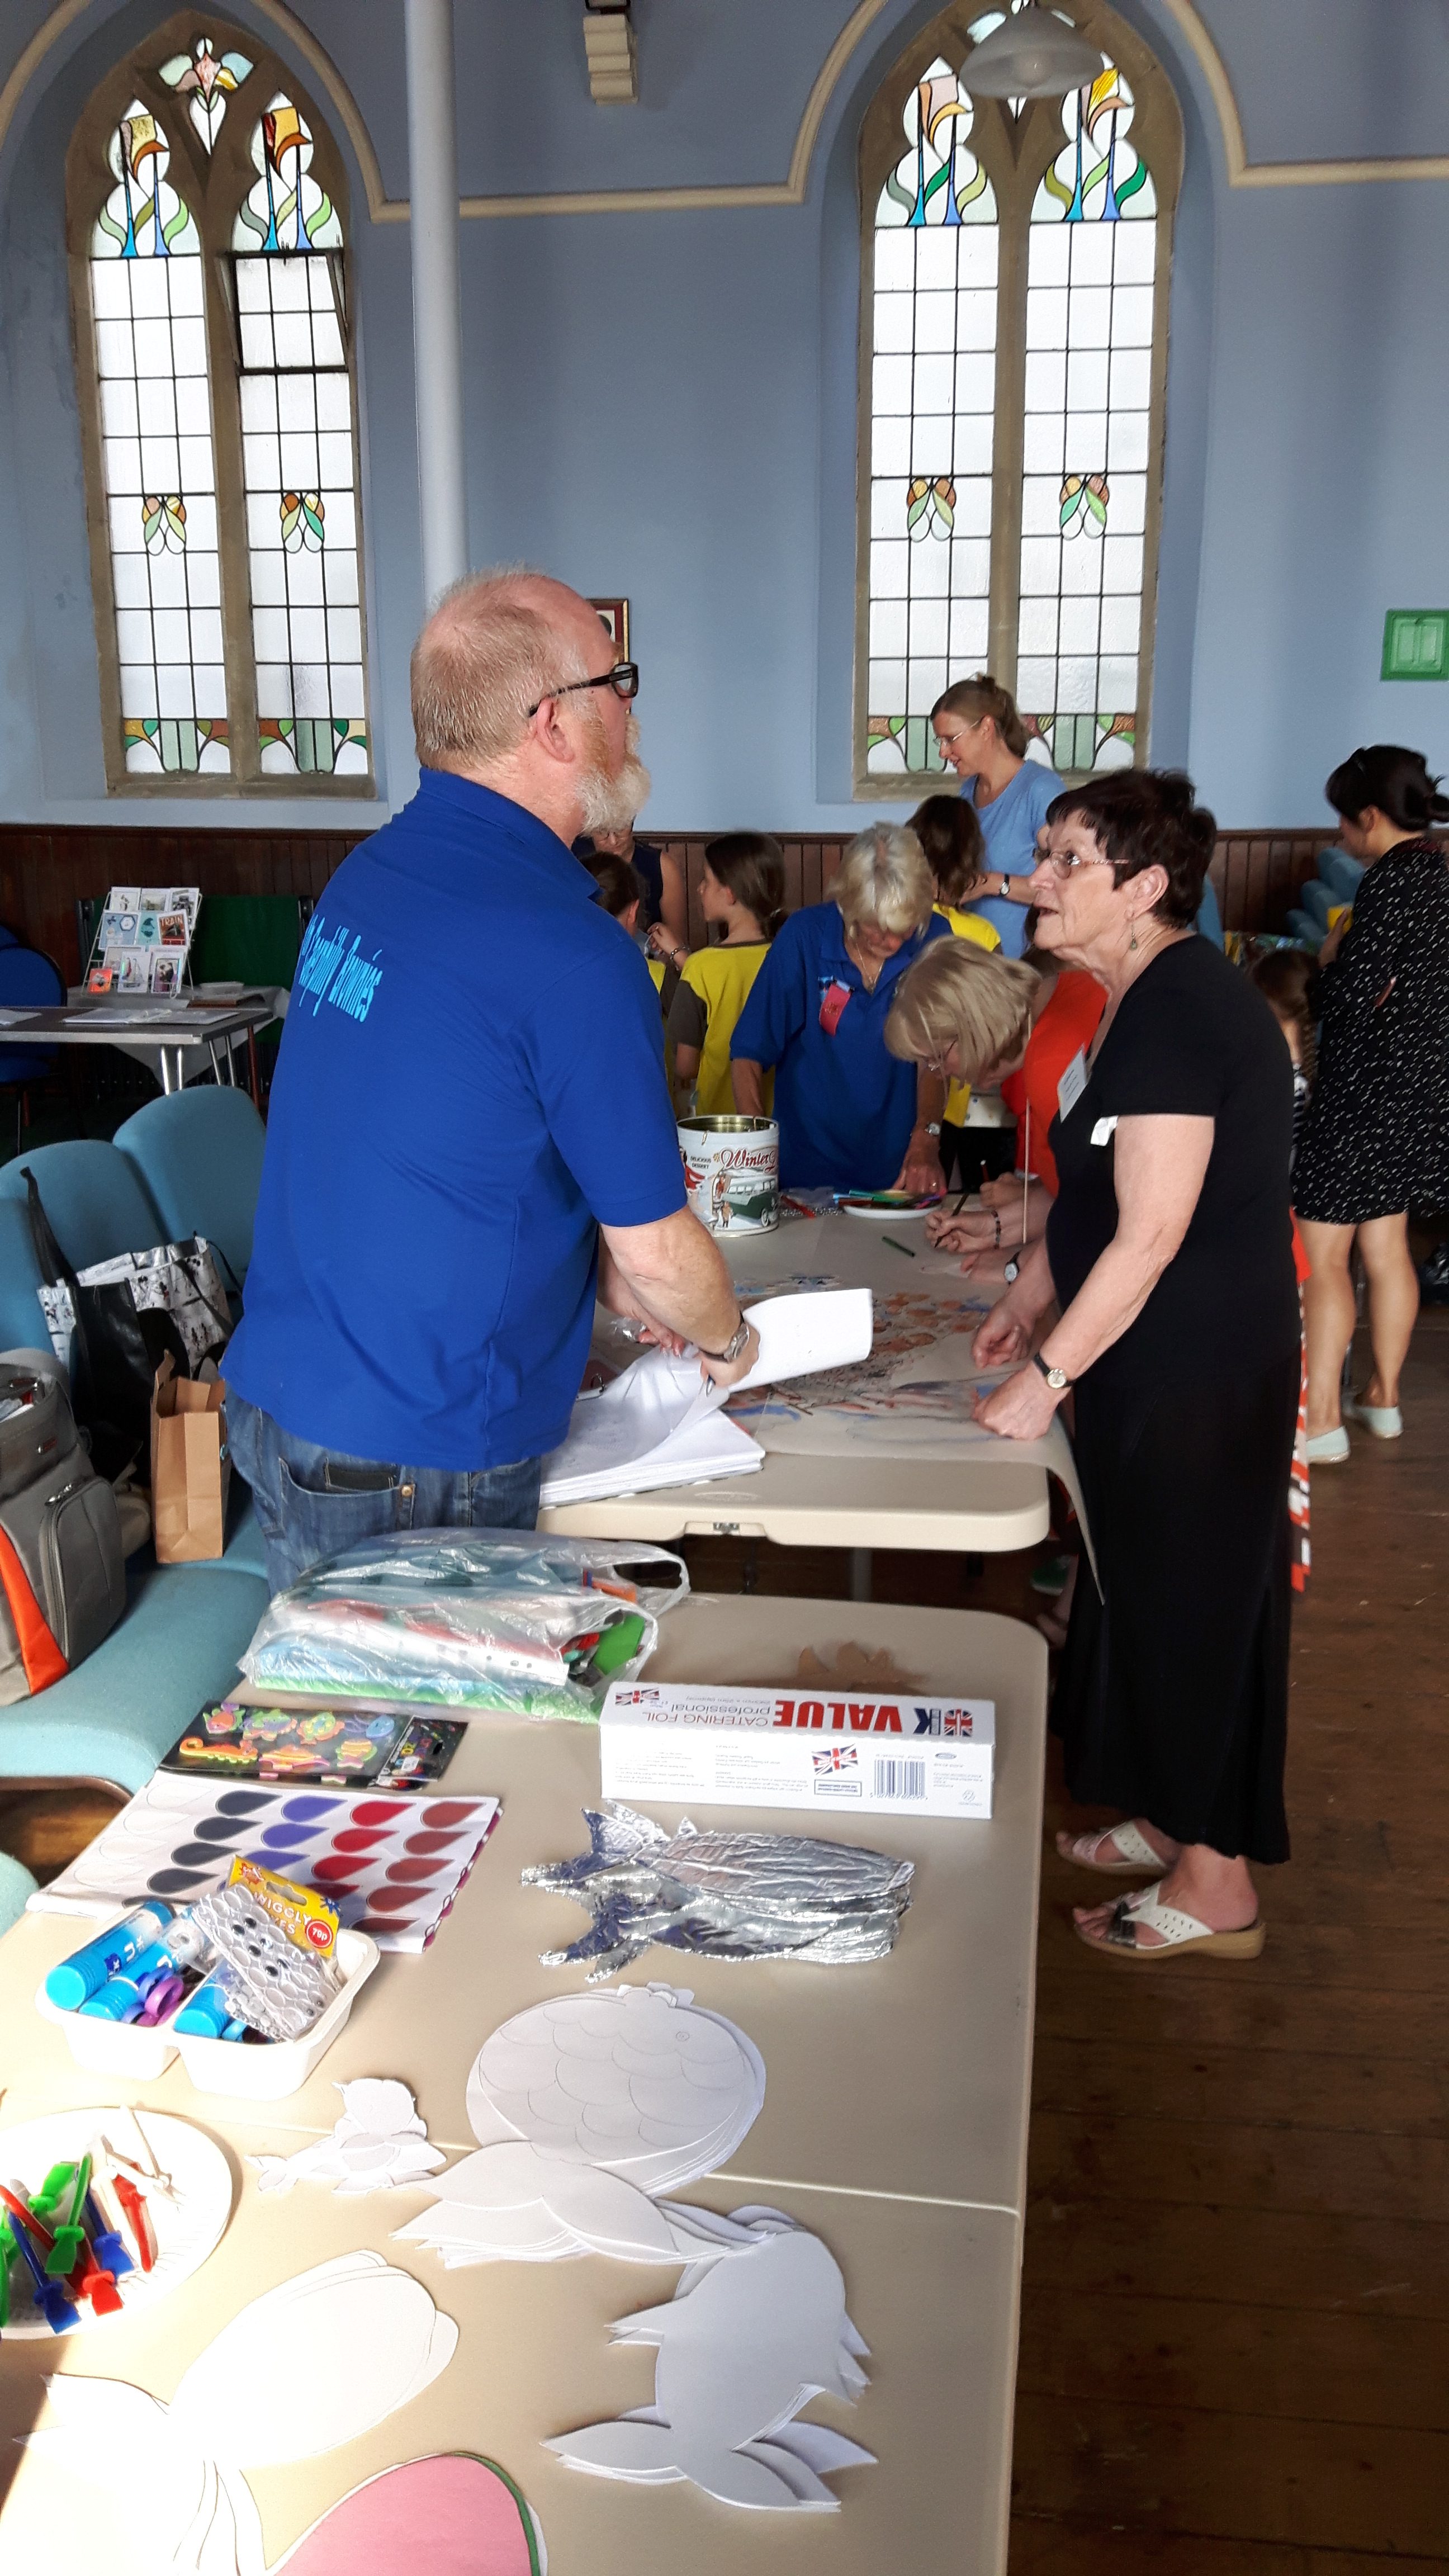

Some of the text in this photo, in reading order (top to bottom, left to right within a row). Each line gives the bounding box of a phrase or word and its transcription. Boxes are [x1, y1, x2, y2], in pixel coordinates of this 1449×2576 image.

[161, 915, 183, 926] TRAIN
[328, 935, 383, 1022] Brownies
[720, 1148, 769, 1168] Winter
[671, 1704, 770, 1716] professional
[773, 1700, 902, 1734] VALUE
[642, 1712, 768, 1727] CATERING FOIL
[253, 1891, 312, 1926] WIGGLY
[312, 1928, 328, 1942] 79p
